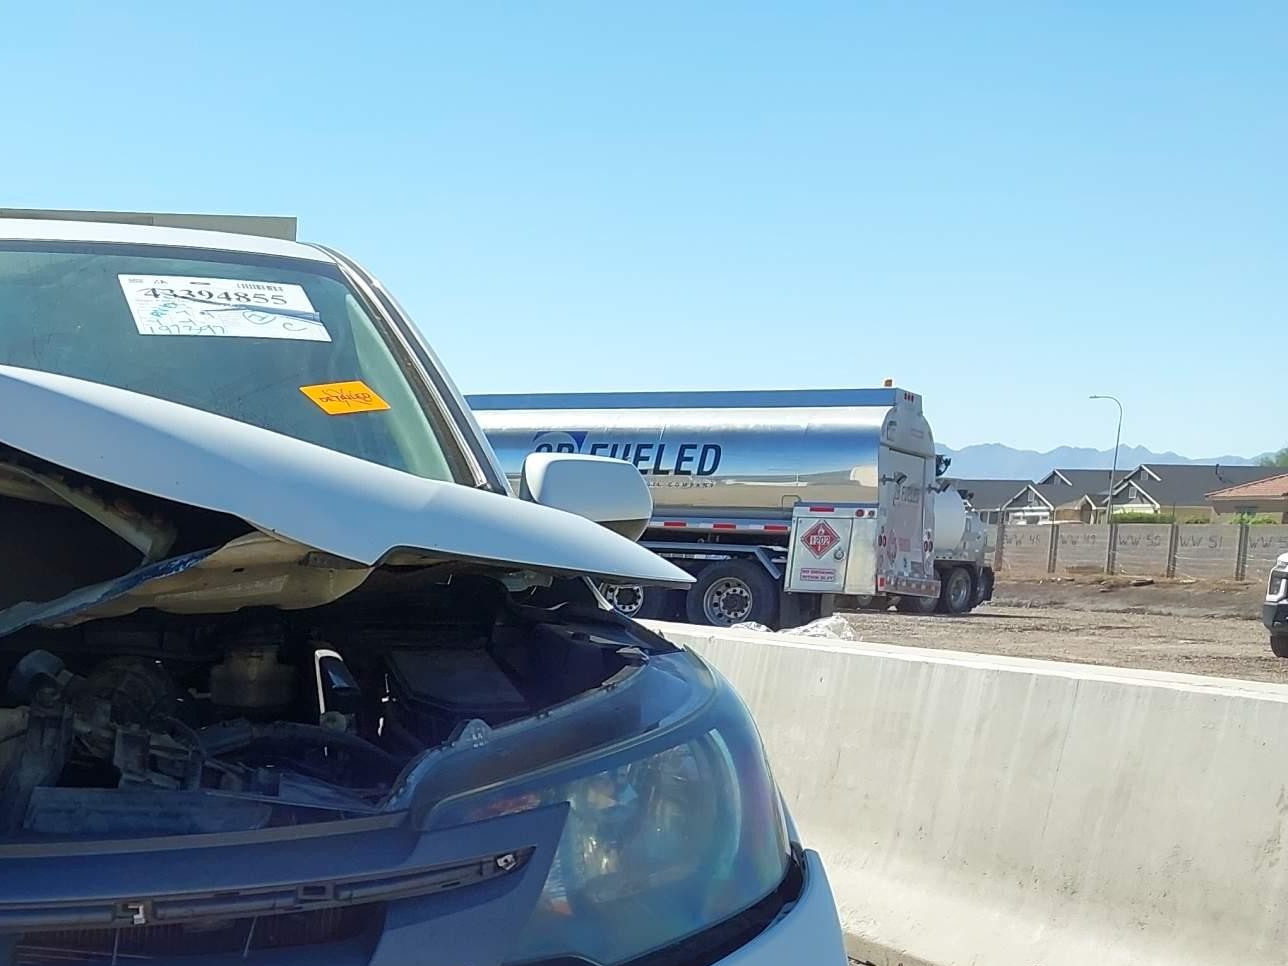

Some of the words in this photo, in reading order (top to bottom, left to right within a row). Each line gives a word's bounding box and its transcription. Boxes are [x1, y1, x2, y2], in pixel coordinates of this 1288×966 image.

[142, 287, 288, 305] 43394855
[1118, 534, 1143, 546] WW
[1179, 536, 1203, 548] WW
[1208, 536, 1224, 549] 51
